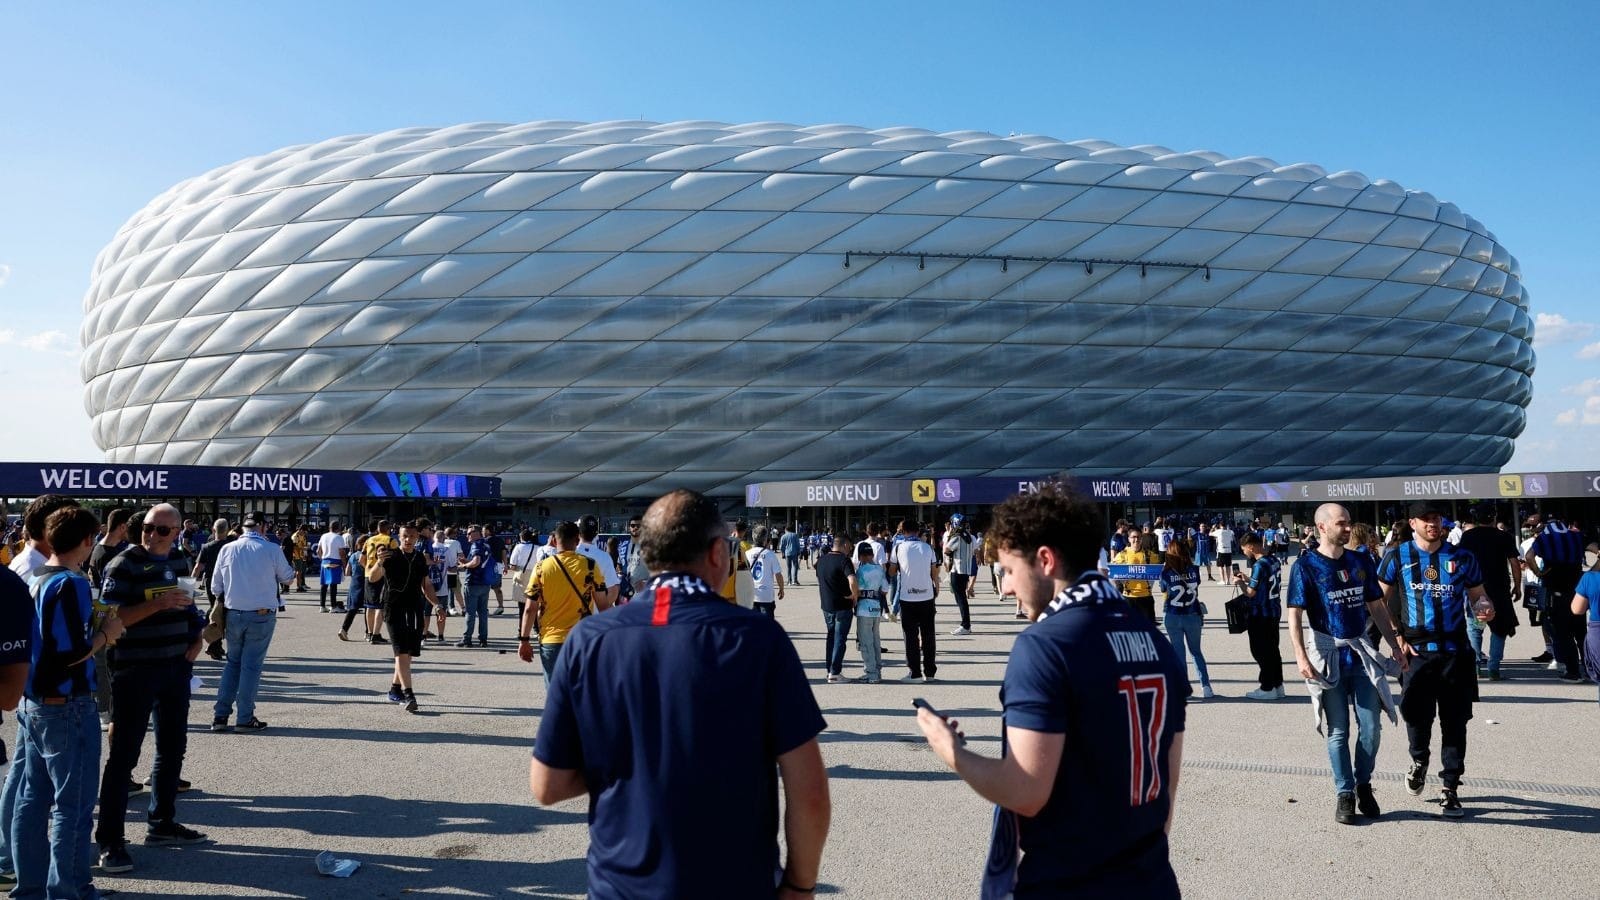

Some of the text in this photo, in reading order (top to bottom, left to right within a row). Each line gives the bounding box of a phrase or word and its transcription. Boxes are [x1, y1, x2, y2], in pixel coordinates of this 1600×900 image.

[40, 469, 322, 492] WELCOME BENVENUT
[1092, 481, 1130, 497] WELCOME
[1327, 482, 1375, 497] BENVENUTI
[1404, 479, 1471, 496] BIENVENU
[806, 484, 880, 501] BENVENU
[1128, 565, 1146, 574] INTER
[1409, 580, 1454, 591] betsson
[1170, 582, 1198, 607] 23
[0, 640, 27, 651] OAT
[1106, 631, 1159, 662] VITINHA
[1118, 674, 1167, 806] 17
